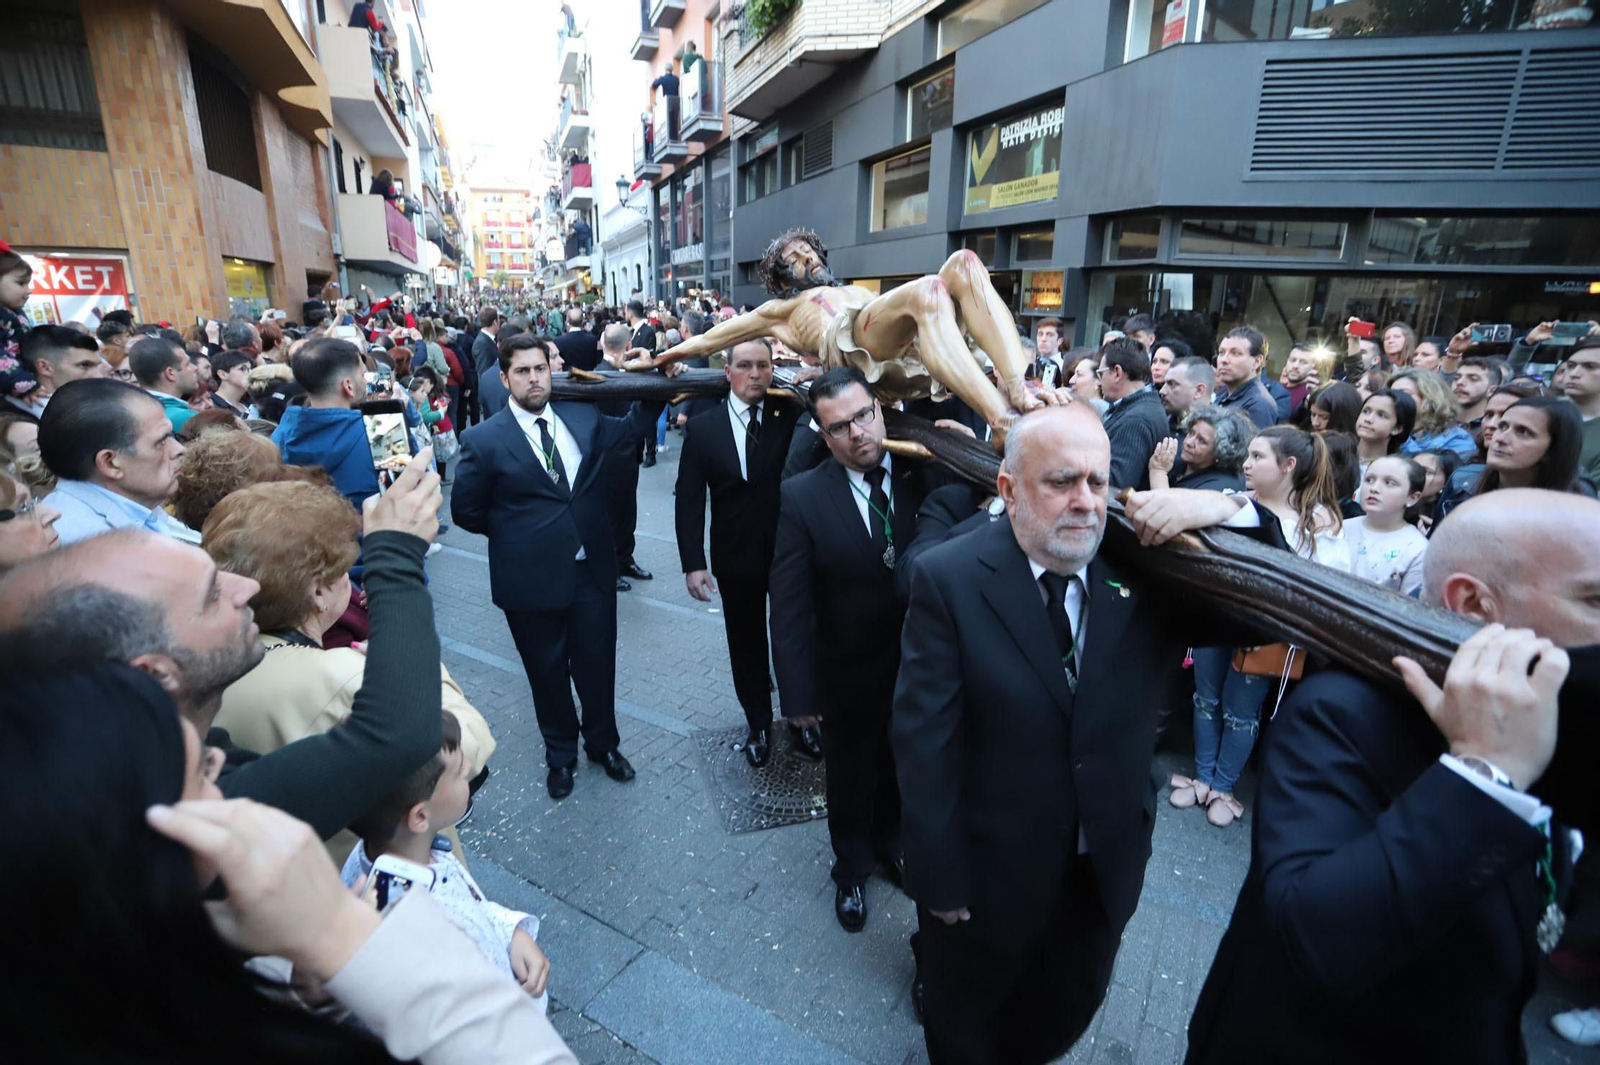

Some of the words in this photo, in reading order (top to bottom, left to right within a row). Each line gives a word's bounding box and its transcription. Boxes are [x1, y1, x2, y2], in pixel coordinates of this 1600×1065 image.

[1001, 116, 1038, 139] PATRIZIA
[1013, 178, 1038, 190] GANADOR
[28, 263, 114, 290] RKET
